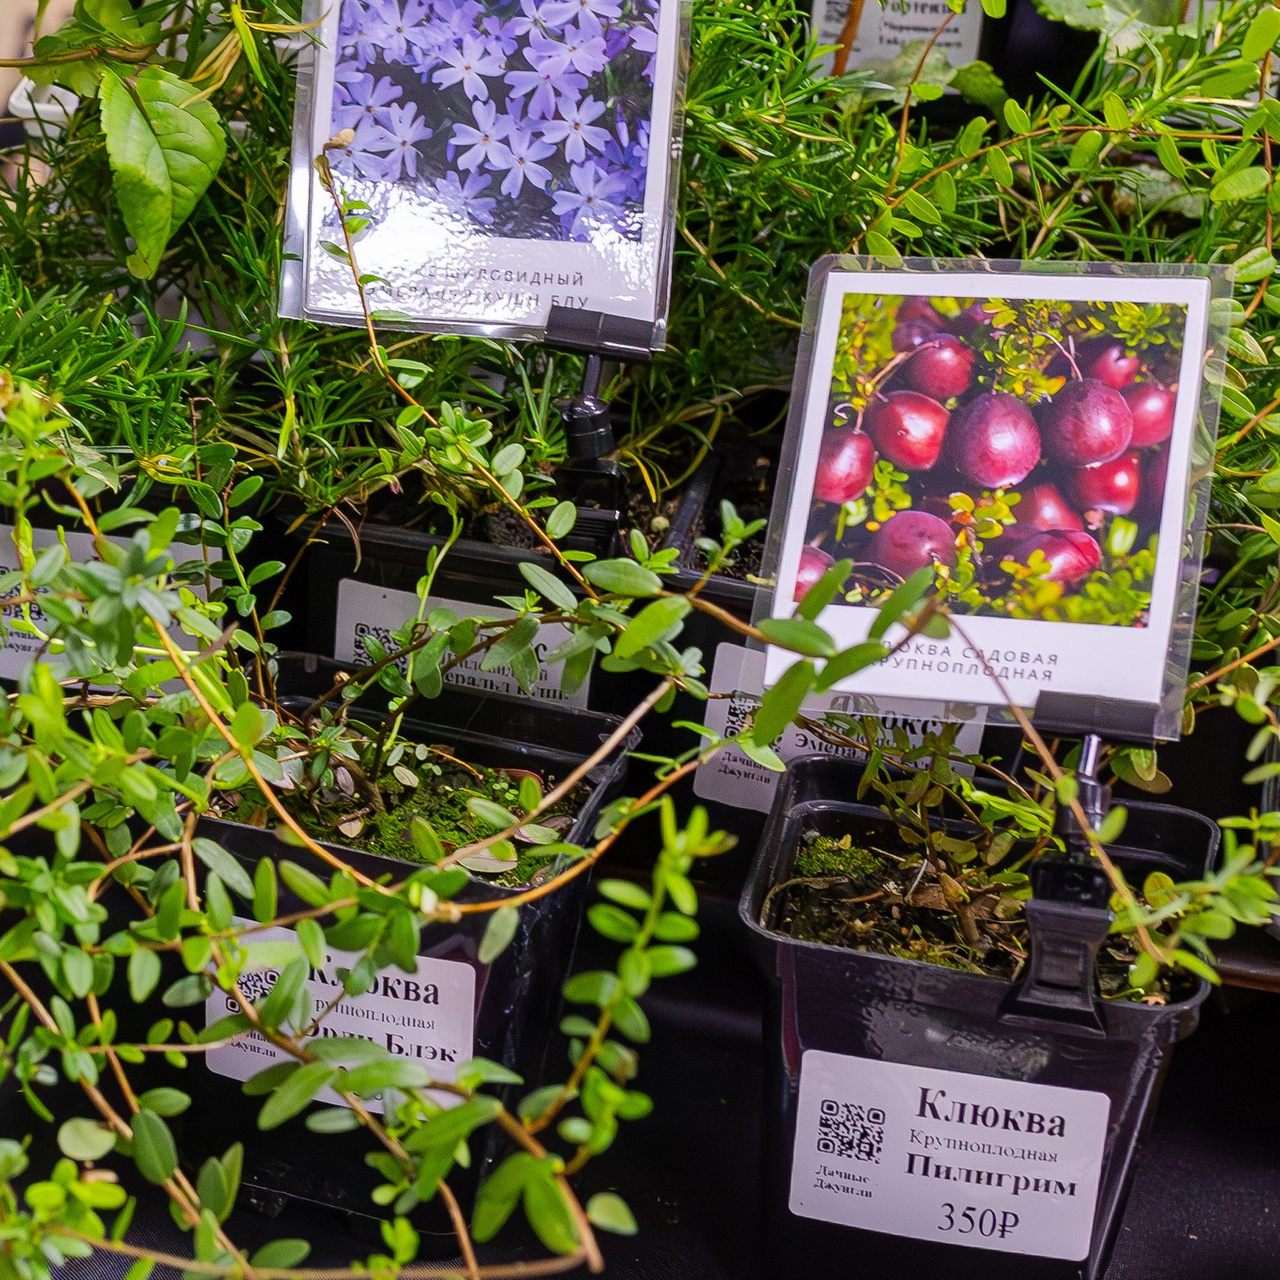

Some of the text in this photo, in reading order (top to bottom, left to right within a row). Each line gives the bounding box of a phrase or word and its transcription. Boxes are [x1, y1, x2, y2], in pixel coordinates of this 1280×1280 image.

[871, 657, 1053, 682] РУПНОПЛОДНАЯ
[314, 998, 436, 1031] рупноплодная
[384, 1032, 458, 1063] Блэк
[915, 1085, 1067, 1138] Клюква
[908, 1127, 1059, 1164] Крупноплодная
[813, 1178, 873, 1199] Джунгли
[815, 1164, 871, 1184] Дачные
[904, 1152, 1078, 1197] Пилигрим
[937, 1202, 1021, 1240] 350₽
